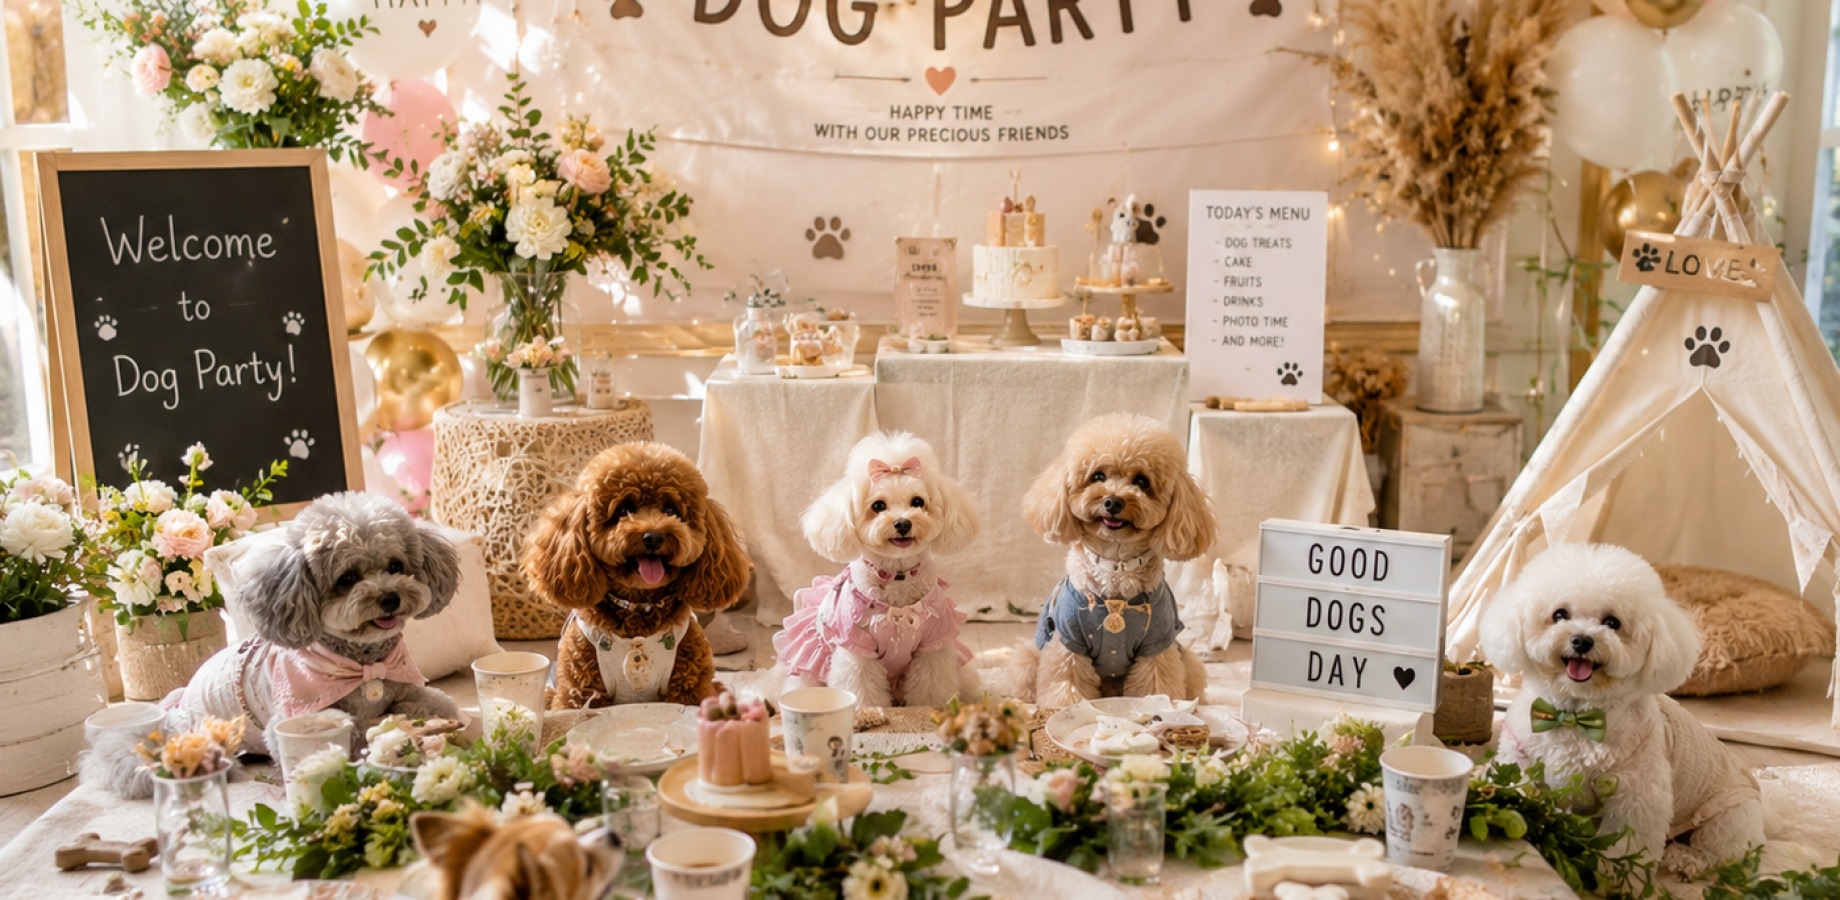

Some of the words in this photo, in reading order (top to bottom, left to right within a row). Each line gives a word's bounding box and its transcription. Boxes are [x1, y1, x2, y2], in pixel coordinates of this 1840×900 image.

[933, 0, 1192, 51] PAR
[890, 104, 945, 120] HAPPY
[953, 104, 993, 120] TIME
[814, 122, 858, 139] WITH
[865, 126, 900, 142] OUR
[907, 127, 991, 143] PRECIOUS
[998, 124, 1070, 142] FRIENDS
[1206, 204, 1264, 220] TODAY'S
[1269, 206, 1311, 221] MENU
[100, 213, 277, 266] Welcome
[1225, 236, 1248, 249] DOG
[1252, 236, 1292, 250] TREATS
[1224, 256, 1253, 268] CAKE
[1223, 275, 1263, 288] FRUITS
[177, 290, 211, 322] to
[1223, 295, 1264, 308] DRINKS
[1222, 315, 1259, 328] PHOTO
[1263, 316, 1289, 329] TIME
[1221, 335, 1246, 347] AND
[1249, 335, 1285, 349] MORE!
[112, 354, 180, 410] Dog
[194, 343, 298, 402] Party!
[1308, 542, 1389, 581] GOOD
[1306, 596, 1386, 636] DOGS
[1307, 650, 1368, 689] DAY
